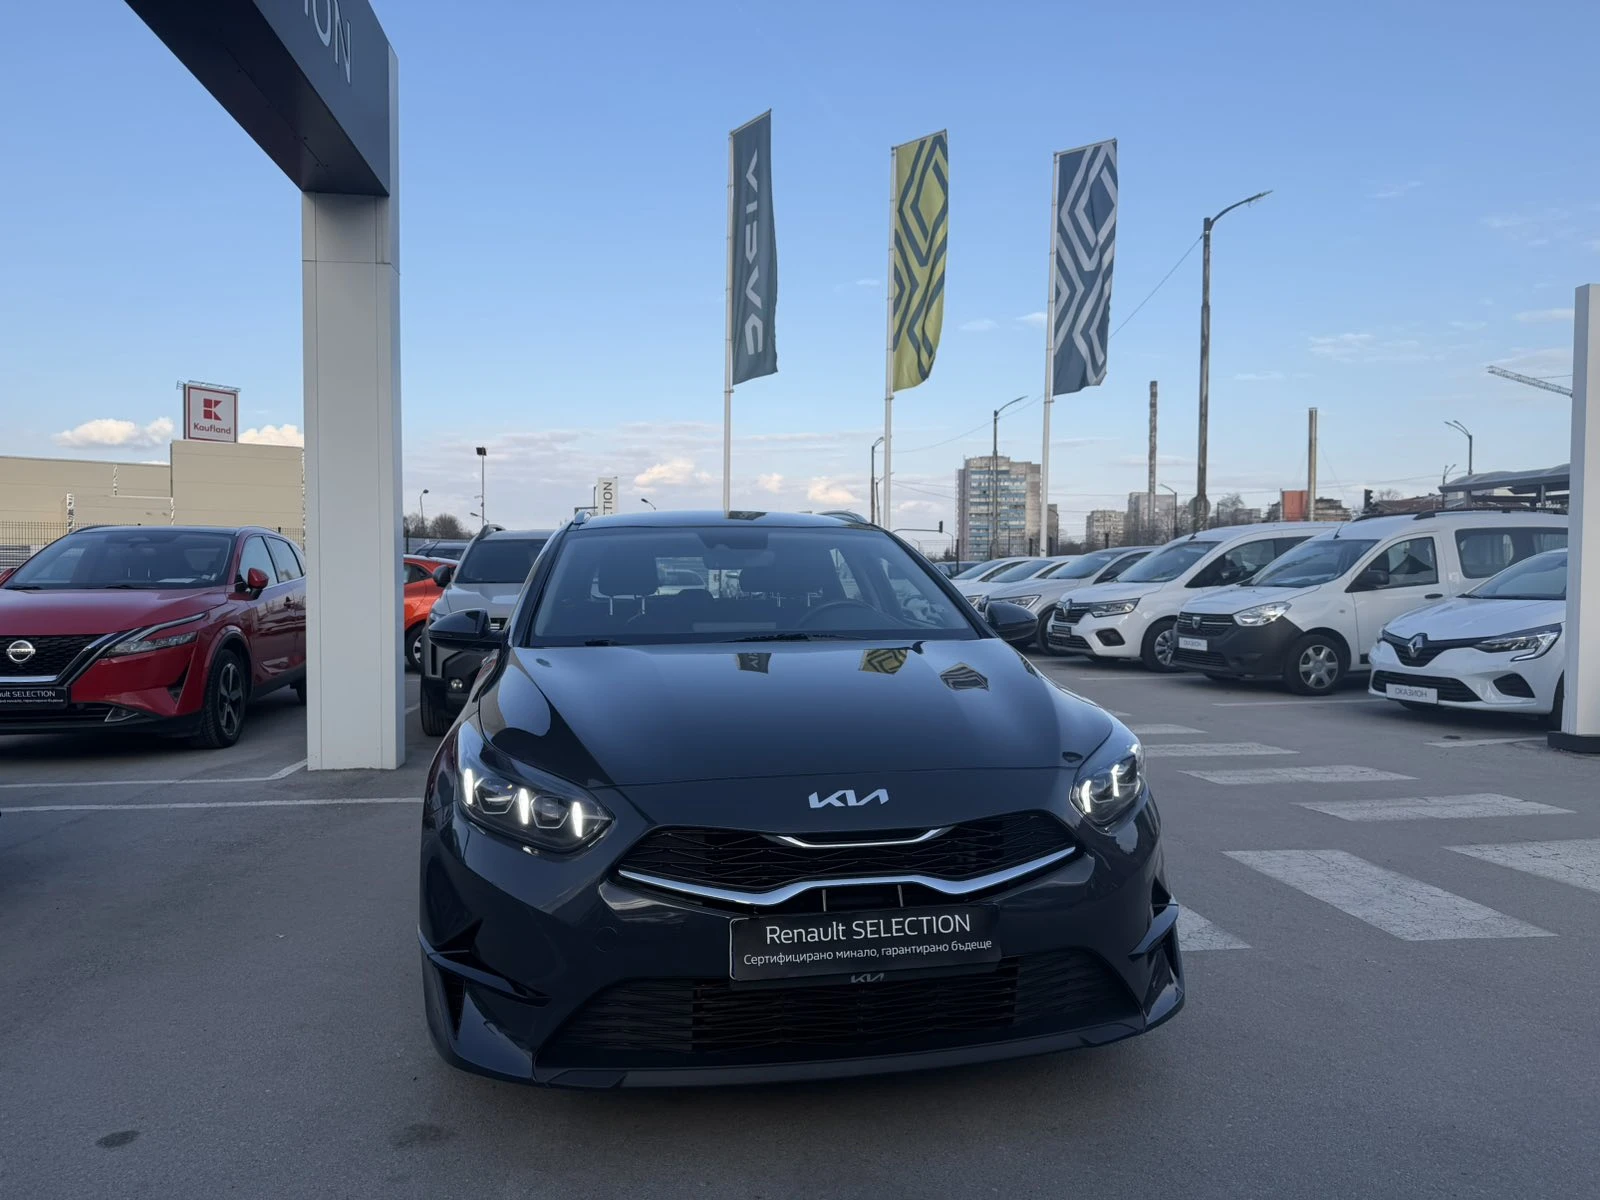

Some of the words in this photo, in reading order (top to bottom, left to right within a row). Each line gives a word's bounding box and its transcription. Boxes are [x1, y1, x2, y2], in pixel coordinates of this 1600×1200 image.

[193, 422, 231, 434] Kaufland
[603, 481, 613, 516] TION
[765, 920, 847, 945] Renault
[852, 914, 971, 940] SELECTION
[743, 950, 834, 967] Сертифицирано
[835, 947, 880, 960] минало,
[881, 942, 950, 958] гарантирано
[950, 940, 992, 952] бъдеще
